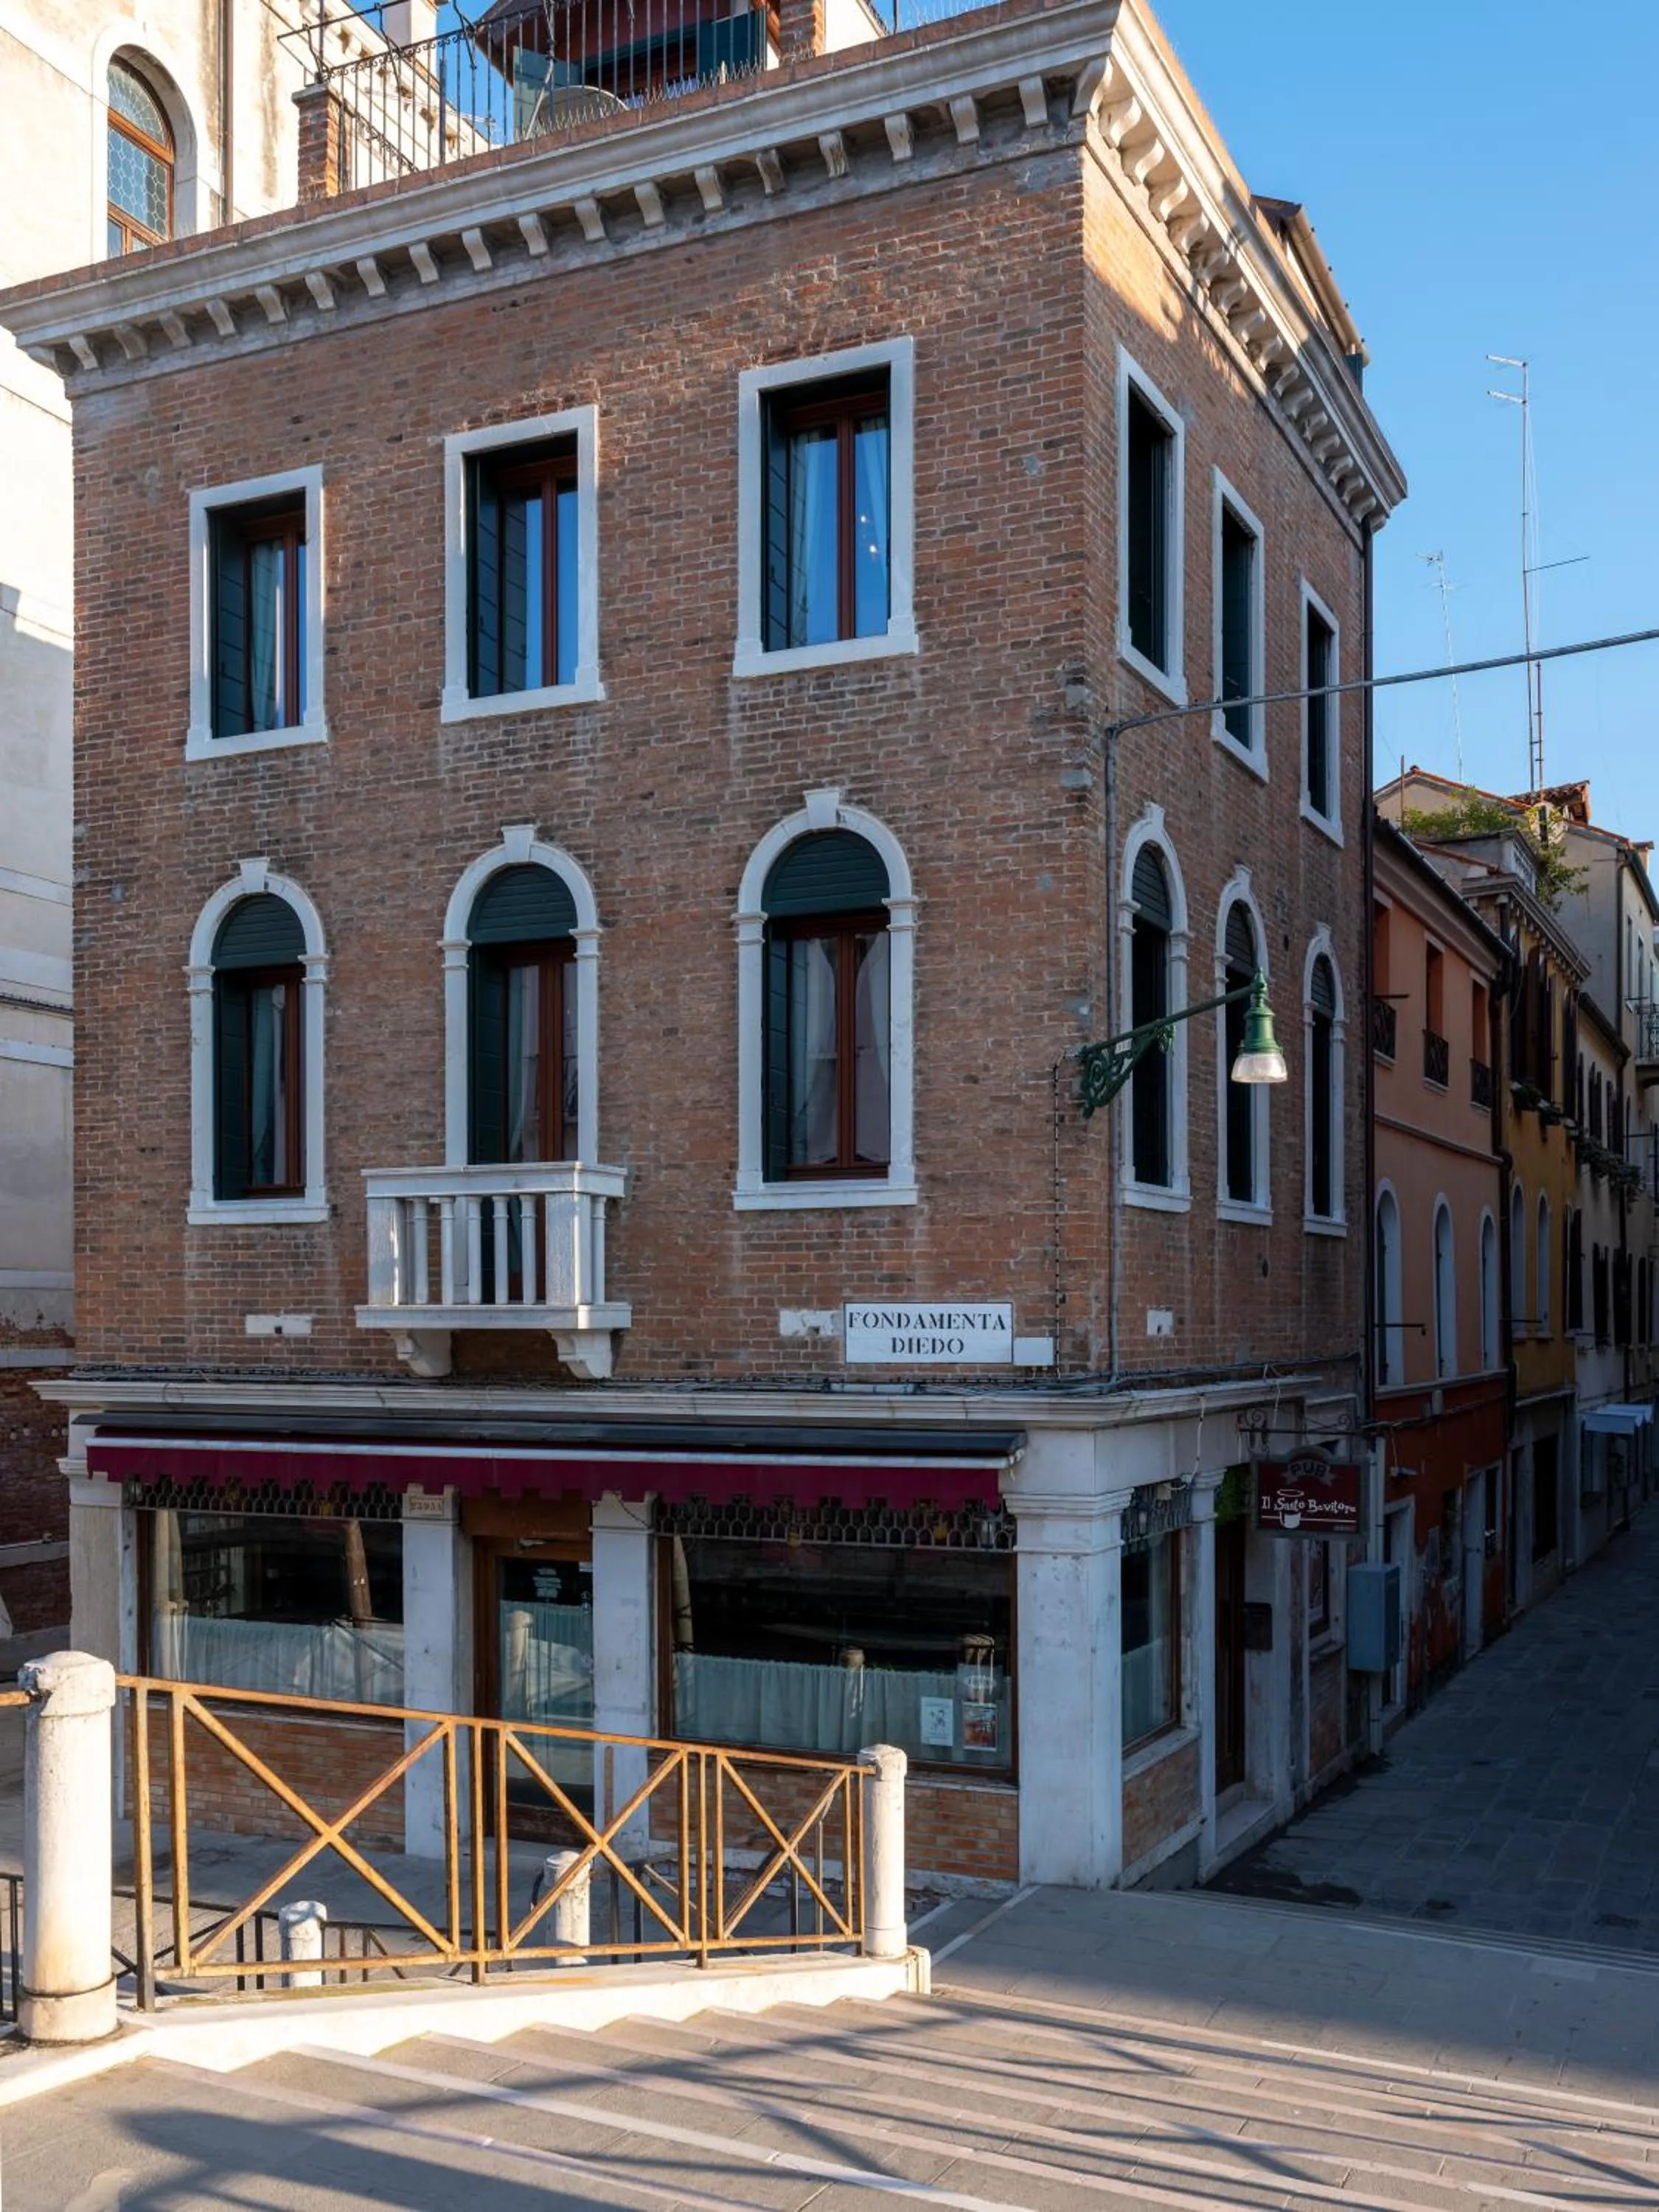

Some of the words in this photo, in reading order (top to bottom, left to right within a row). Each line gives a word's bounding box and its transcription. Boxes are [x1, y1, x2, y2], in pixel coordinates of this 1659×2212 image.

[849, 1311, 1006, 1331] FONDAMENTA
[891, 1336, 965, 1355] DIEDO
[1290, 1462, 1327, 1478] PUB
[1262, 1495, 1271, 1509] Il
